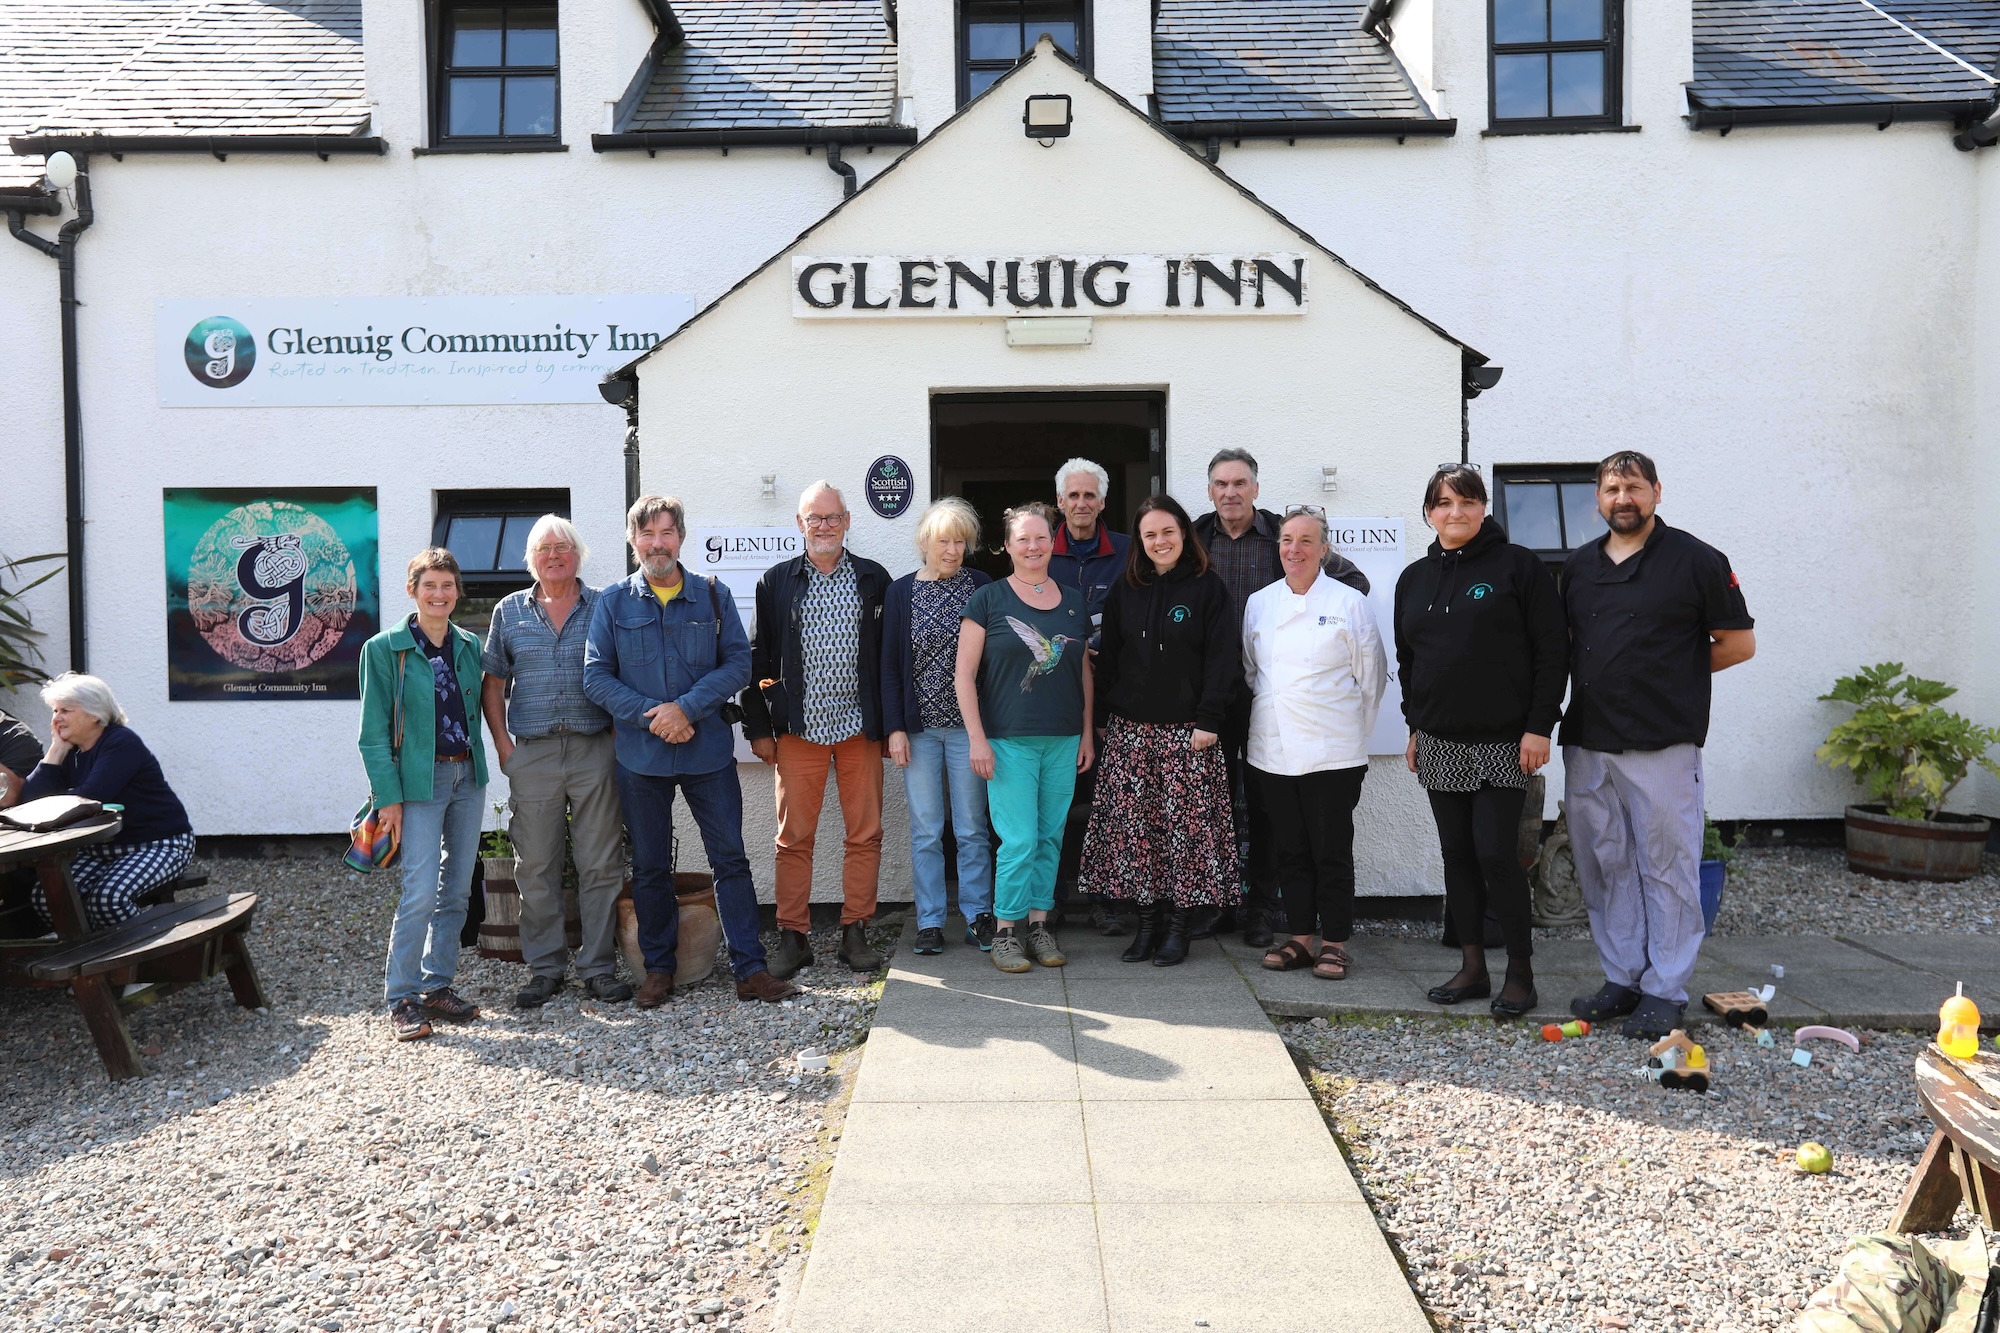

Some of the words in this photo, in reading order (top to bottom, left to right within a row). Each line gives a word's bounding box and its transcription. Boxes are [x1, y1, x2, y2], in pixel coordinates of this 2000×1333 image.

[799, 259, 1129, 309] GLENUIG
[1165, 258, 1305, 308] INN
[267, 325, 394, 361] Glenuig
[401, 323, 600, 359] Community
[606, 324, 662, 351] Inn
[268, 361, 326, 378] Rooted
[333, 363, 354, 375] in
[447, 359, 528, 377] Innspired
[535, 361, 555, 384] by
[871, 477, 907, 486] Scottish
[1361, 529, 1398, 544] INN
[223, 683, 257, 694] Glenuig
[258, 682, 311, 694] Community
[312, 682, 328, 692] Inn
